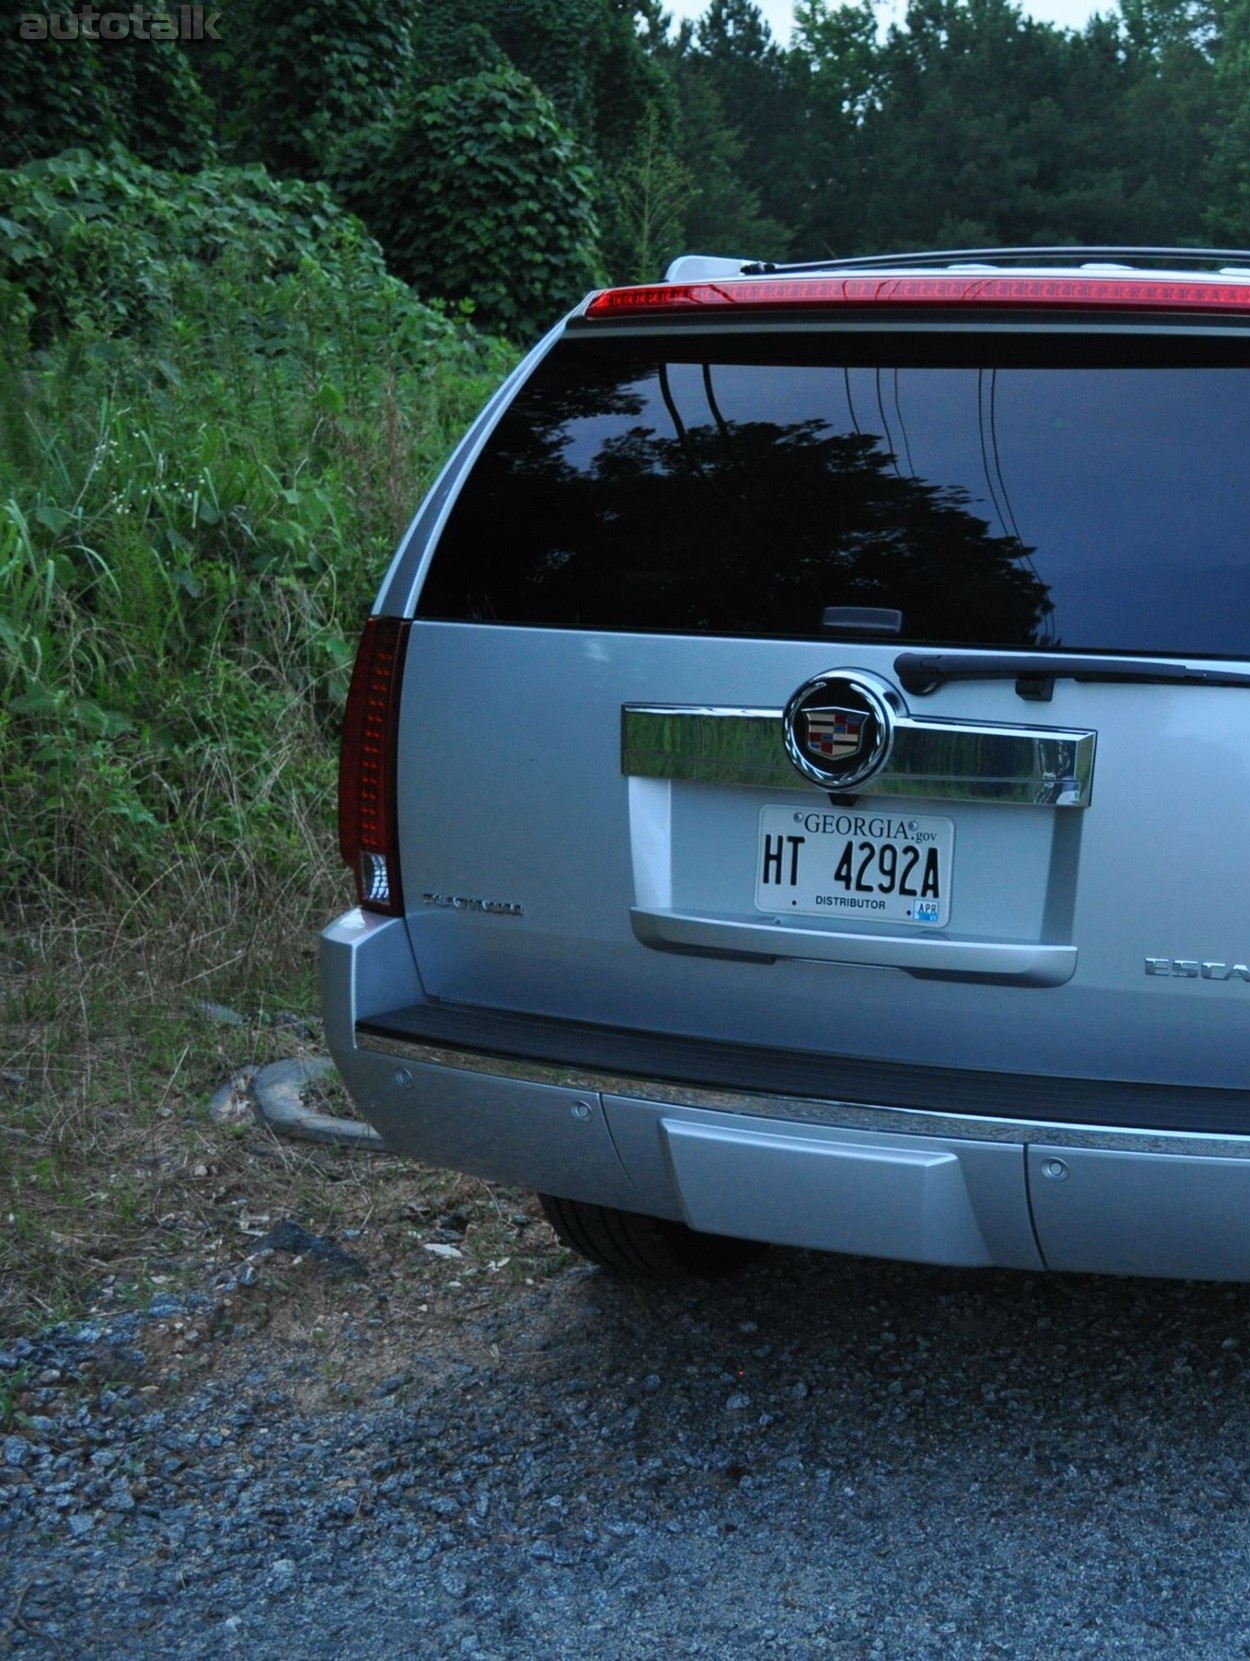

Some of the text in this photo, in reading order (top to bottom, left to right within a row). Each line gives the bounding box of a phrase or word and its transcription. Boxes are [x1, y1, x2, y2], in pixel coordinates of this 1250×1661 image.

[763, 834, 939, 898] HT 4292A
[815, 895, 886, 910] DISTRIBUTOR
[918, 903, 937, 915] APR
